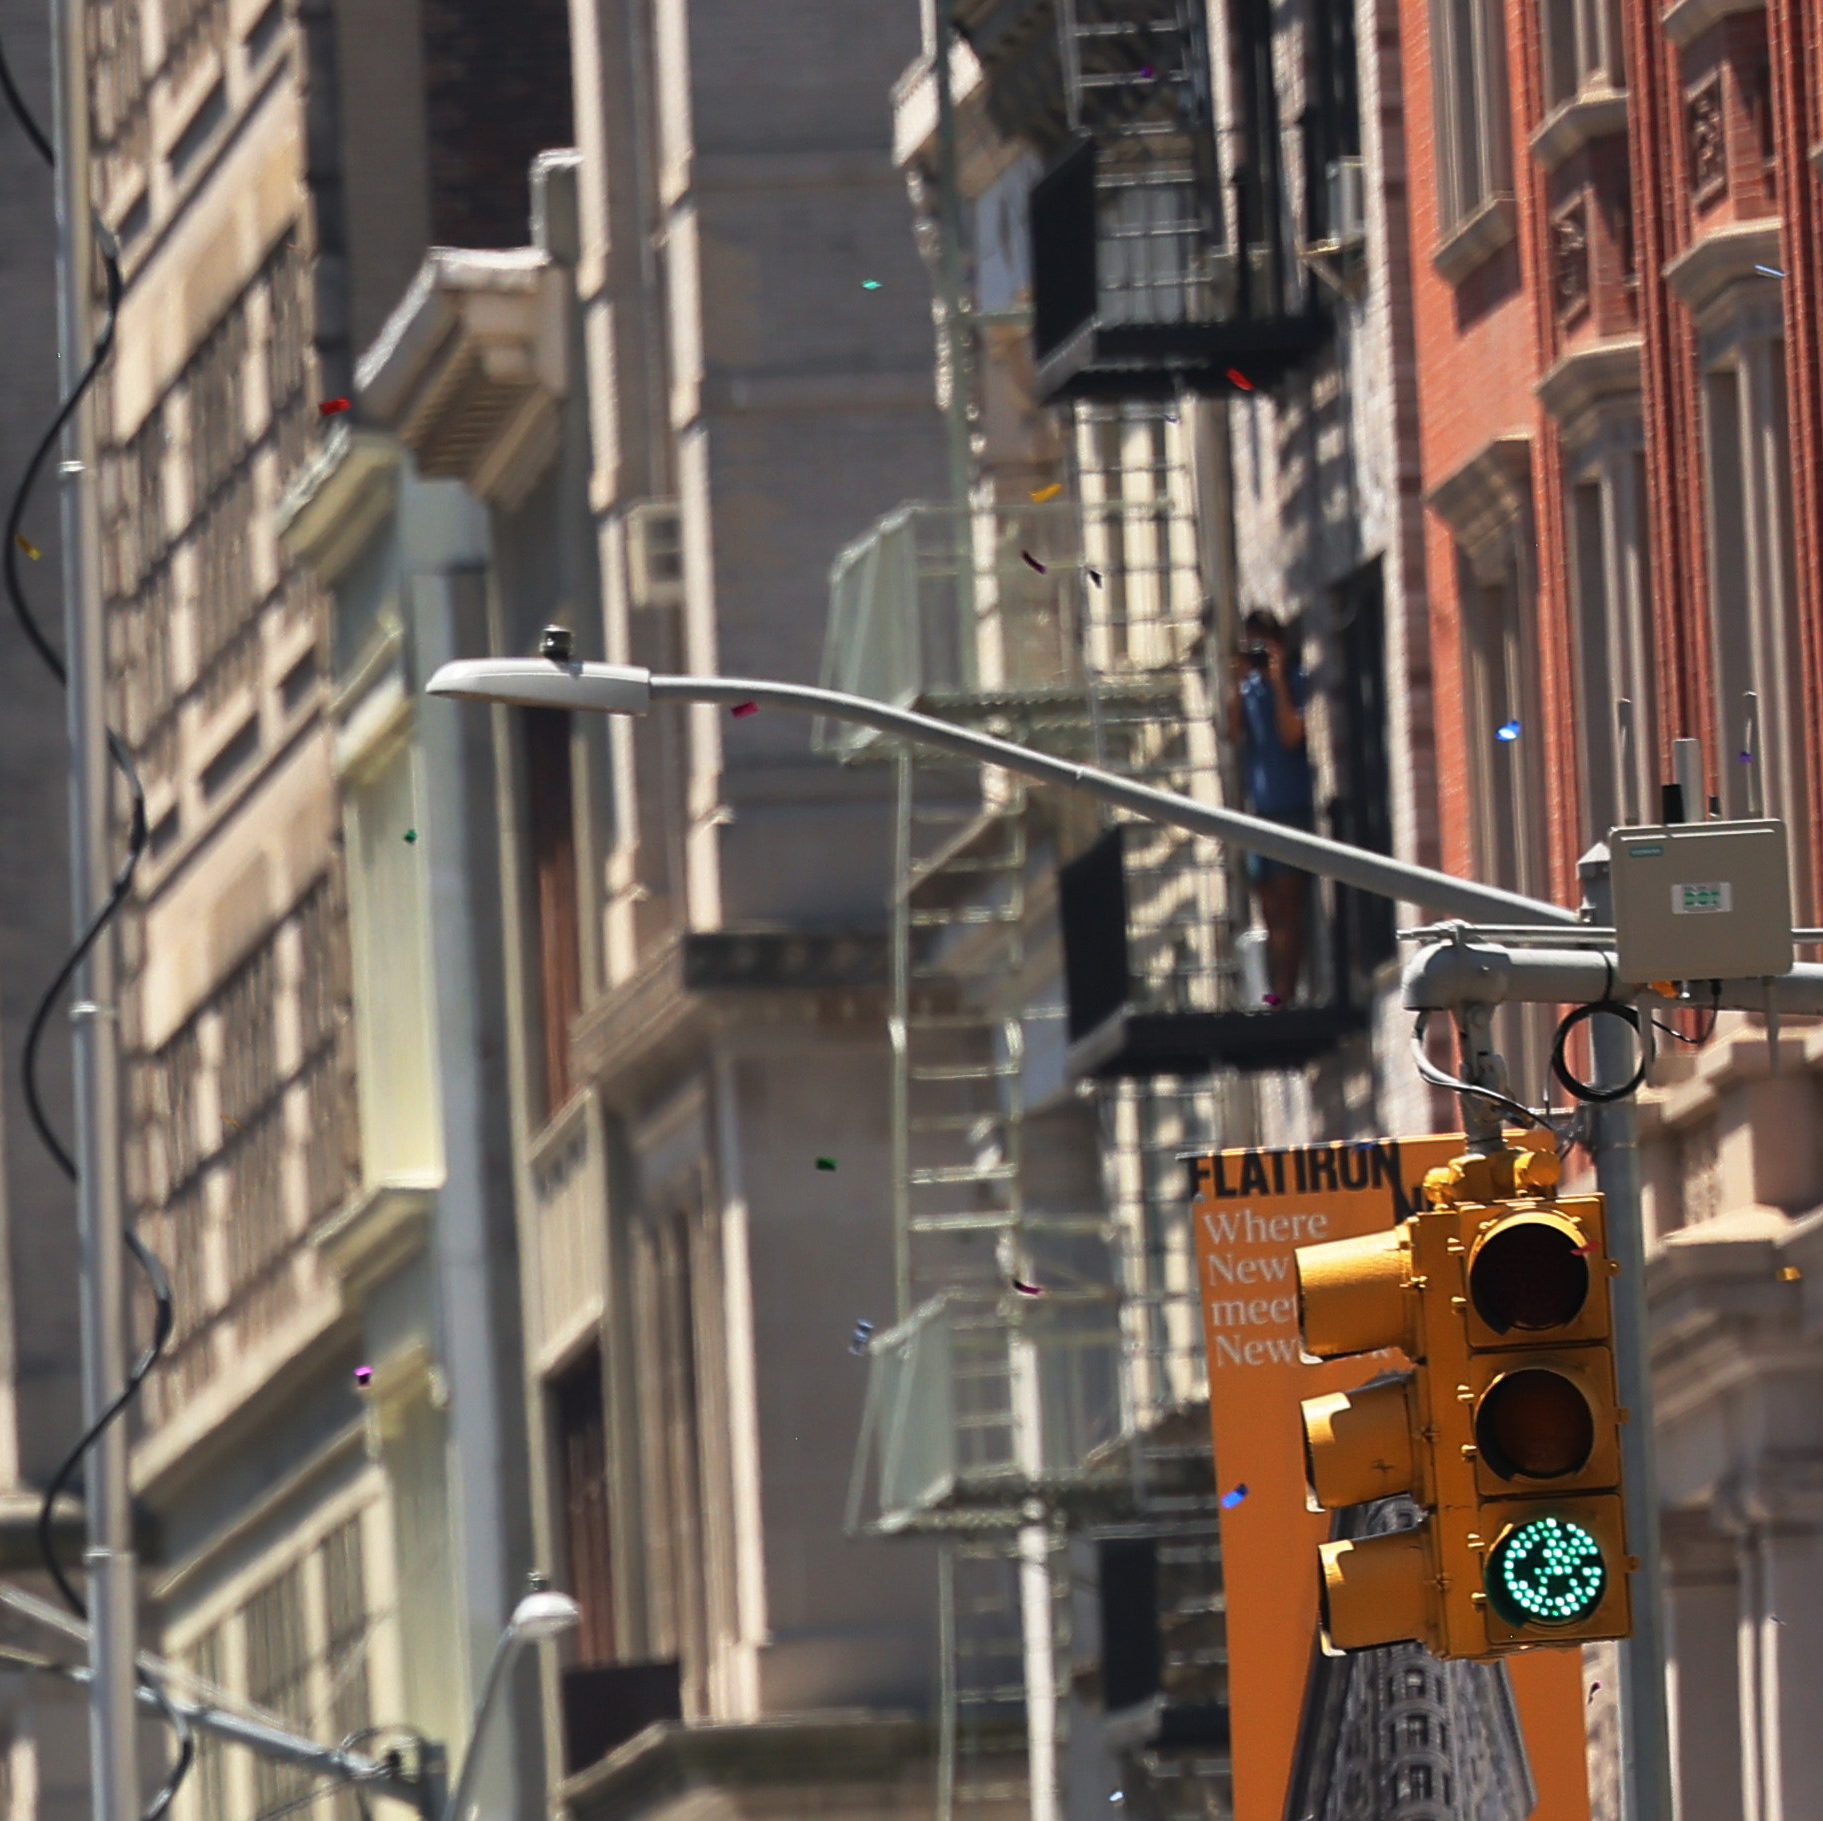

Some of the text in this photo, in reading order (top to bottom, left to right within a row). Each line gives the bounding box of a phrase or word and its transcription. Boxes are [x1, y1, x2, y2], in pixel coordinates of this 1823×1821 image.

[1187, 1142, 1400, 1199] FLATIRON
[1203, 1208, 1330, 1246] Where
[1206, 1253, 1291, 1287] New
[1214, 1333, 1300, 1369] New
